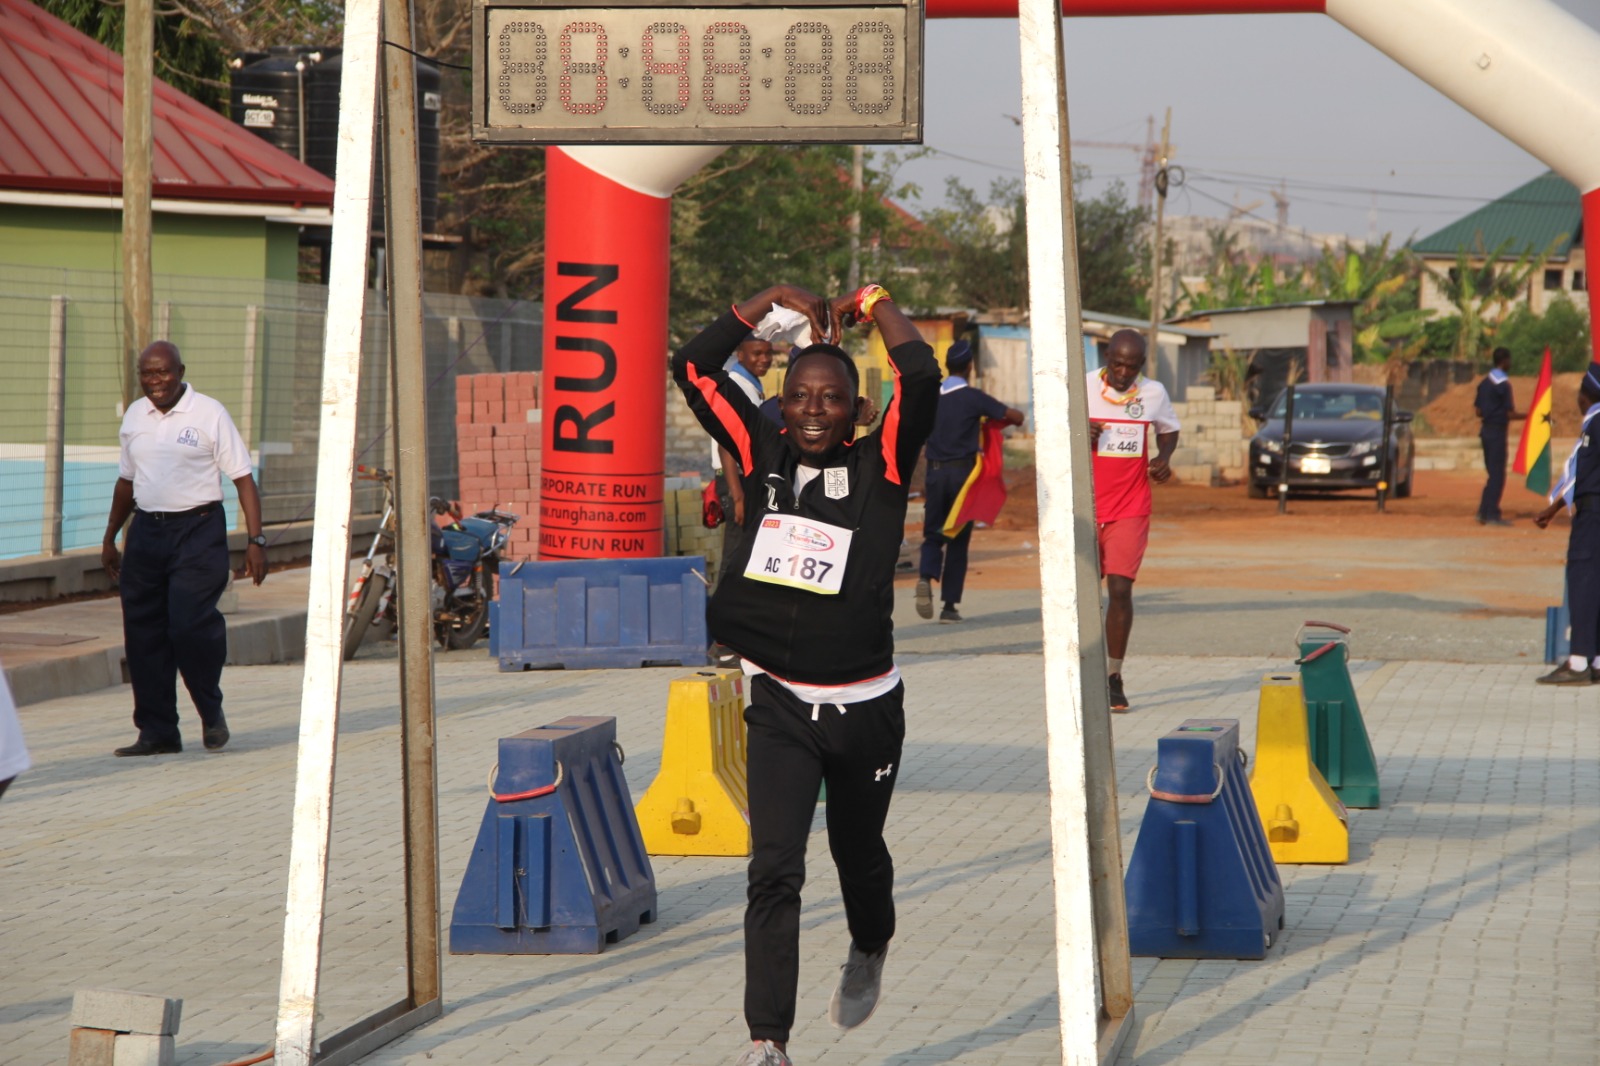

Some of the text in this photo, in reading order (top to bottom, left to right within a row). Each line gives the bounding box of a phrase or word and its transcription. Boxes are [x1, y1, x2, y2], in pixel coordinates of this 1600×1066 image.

[553, 261, 619, 455] RUN
[1117, 441, 1138, 452] 446
[612, 484, 647, 498] RUN
[540, 532, 645, 552] MILY FUN RUN
[764, 554, 834, 584] AC 187
